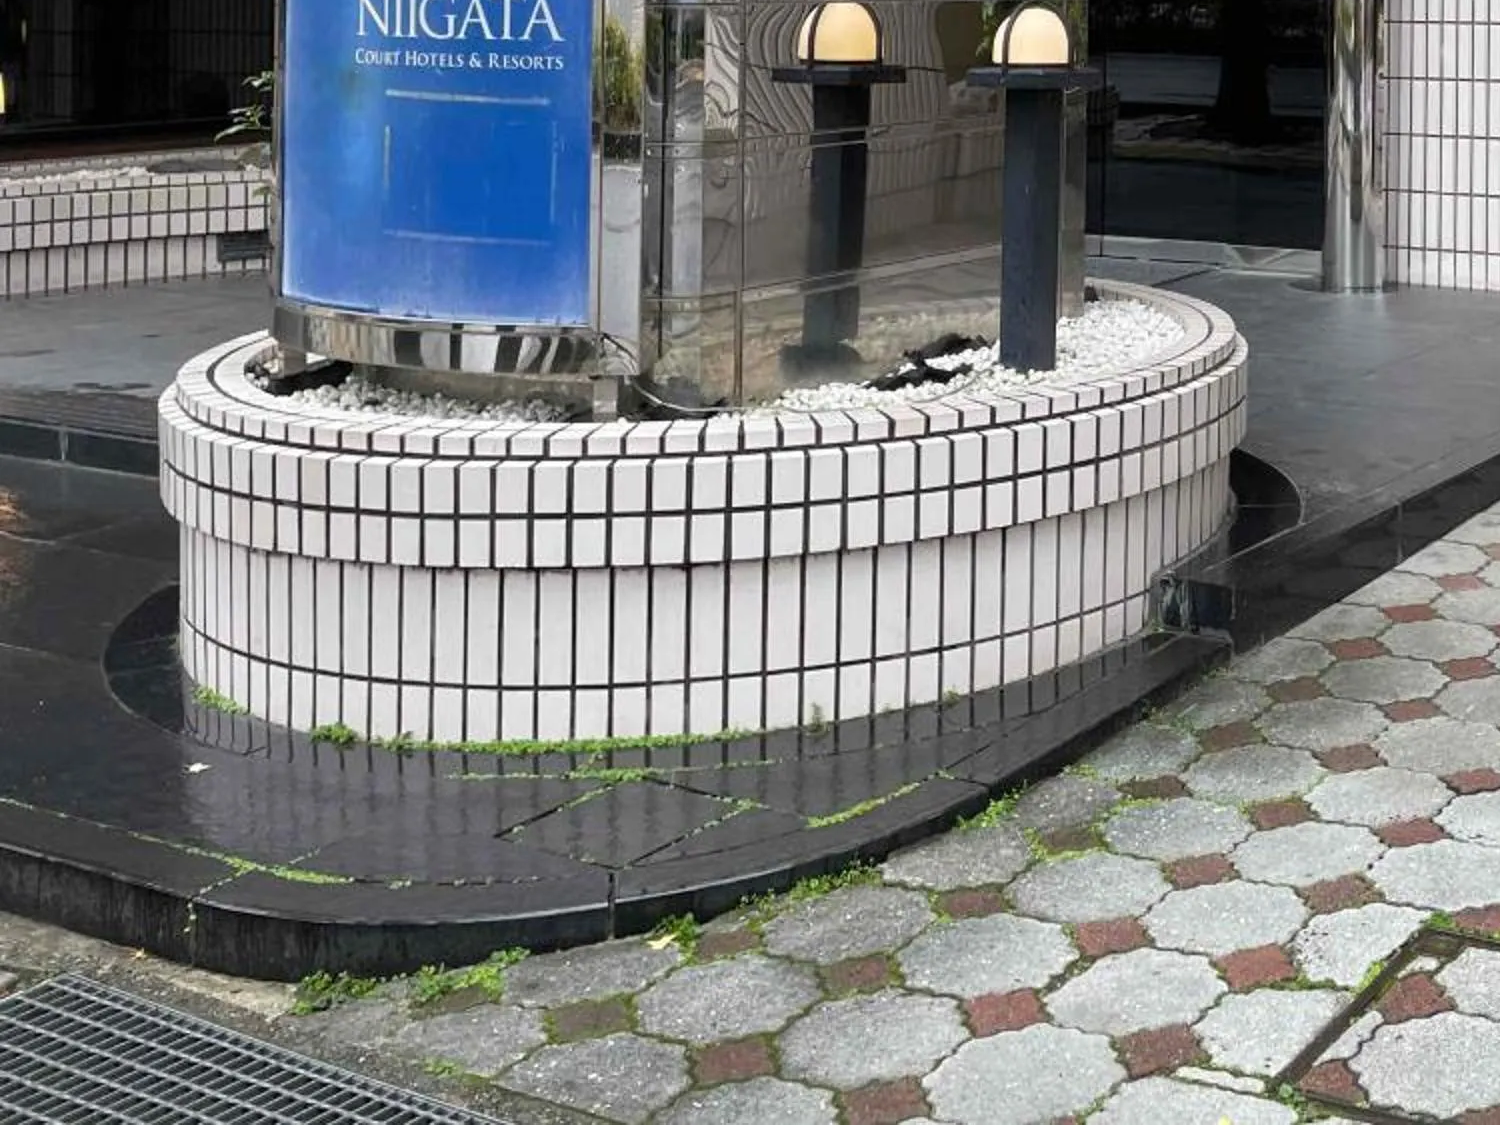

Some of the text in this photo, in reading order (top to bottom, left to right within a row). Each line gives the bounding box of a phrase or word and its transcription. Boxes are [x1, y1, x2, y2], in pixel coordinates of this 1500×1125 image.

[355, 49, 564, 70] COURT HOTELS & RESORTS
